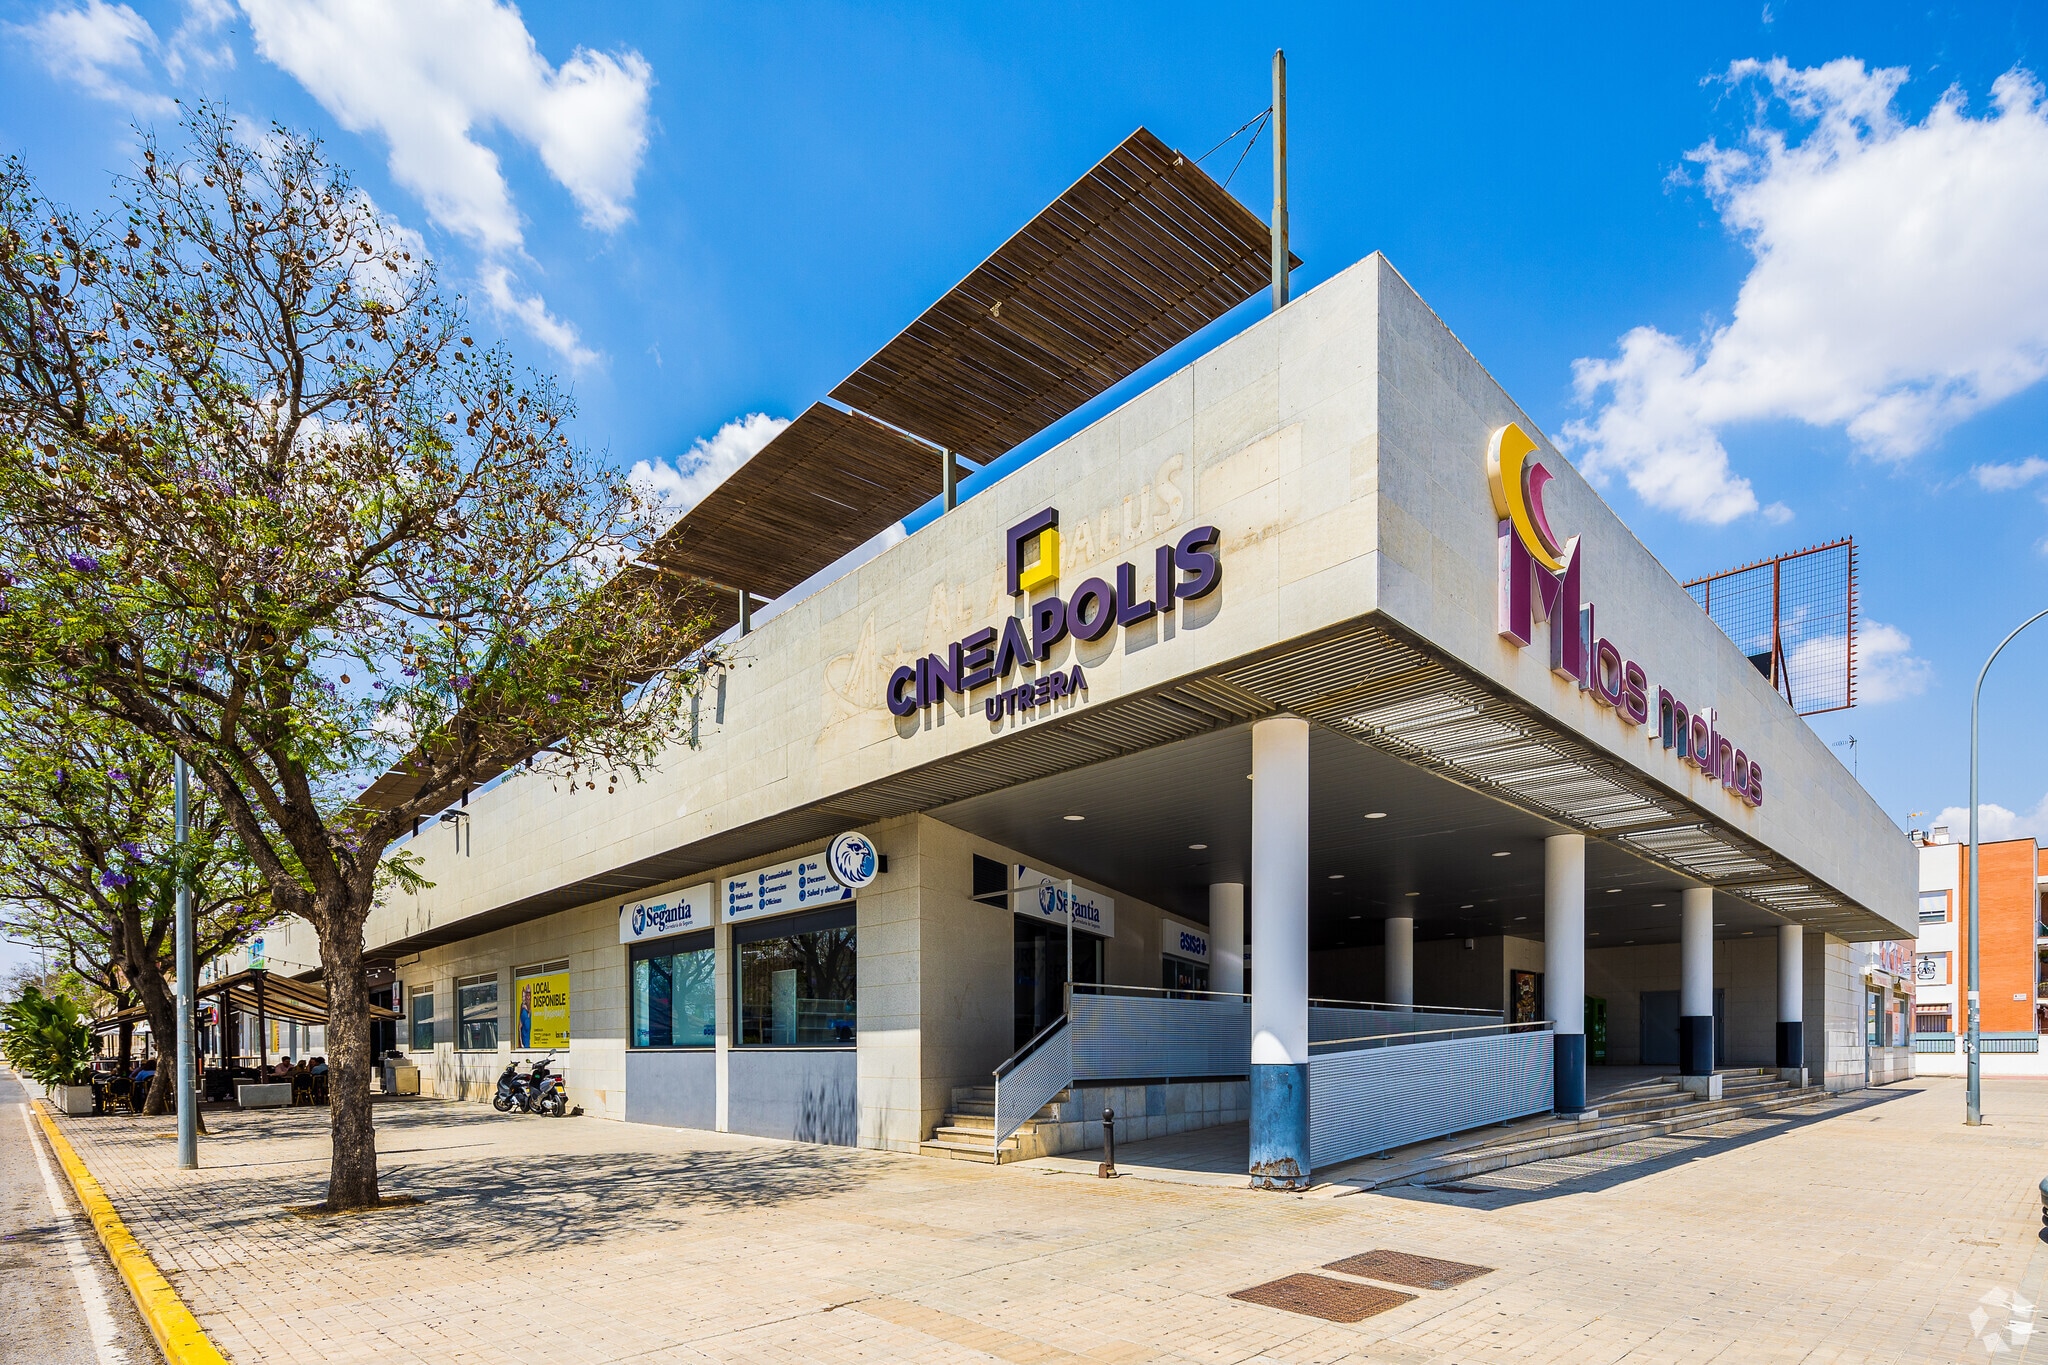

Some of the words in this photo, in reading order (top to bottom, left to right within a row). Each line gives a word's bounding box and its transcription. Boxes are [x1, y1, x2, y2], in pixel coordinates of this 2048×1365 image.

[887, 525, 1222, 717] CINEAPOLIS
[985, 665, 1089, 722] UTRERA
[1579, 600, 1648, 726] los
[1649, 684, 1763, 807] molinos
[806, 862, 818, 871] Vida
[765, 869, 793, 881] Comunidades
[807, 875, 826, 884] Decesos
[735, 881, 747, 889] Hogar
[765, 884, 787, 893] Comercios
[807, 888, 820, 897] Salud
[824, 885, 840, 894] dental
[765, 897, 782, 906] Oficinas
[735, 904, 753, 912] Mascotas
[646, 898, 692, 932] Segantia
[533, 982, 551, 994] LOCAL
[533, 993, 566, 1008] DISPONIBLE
